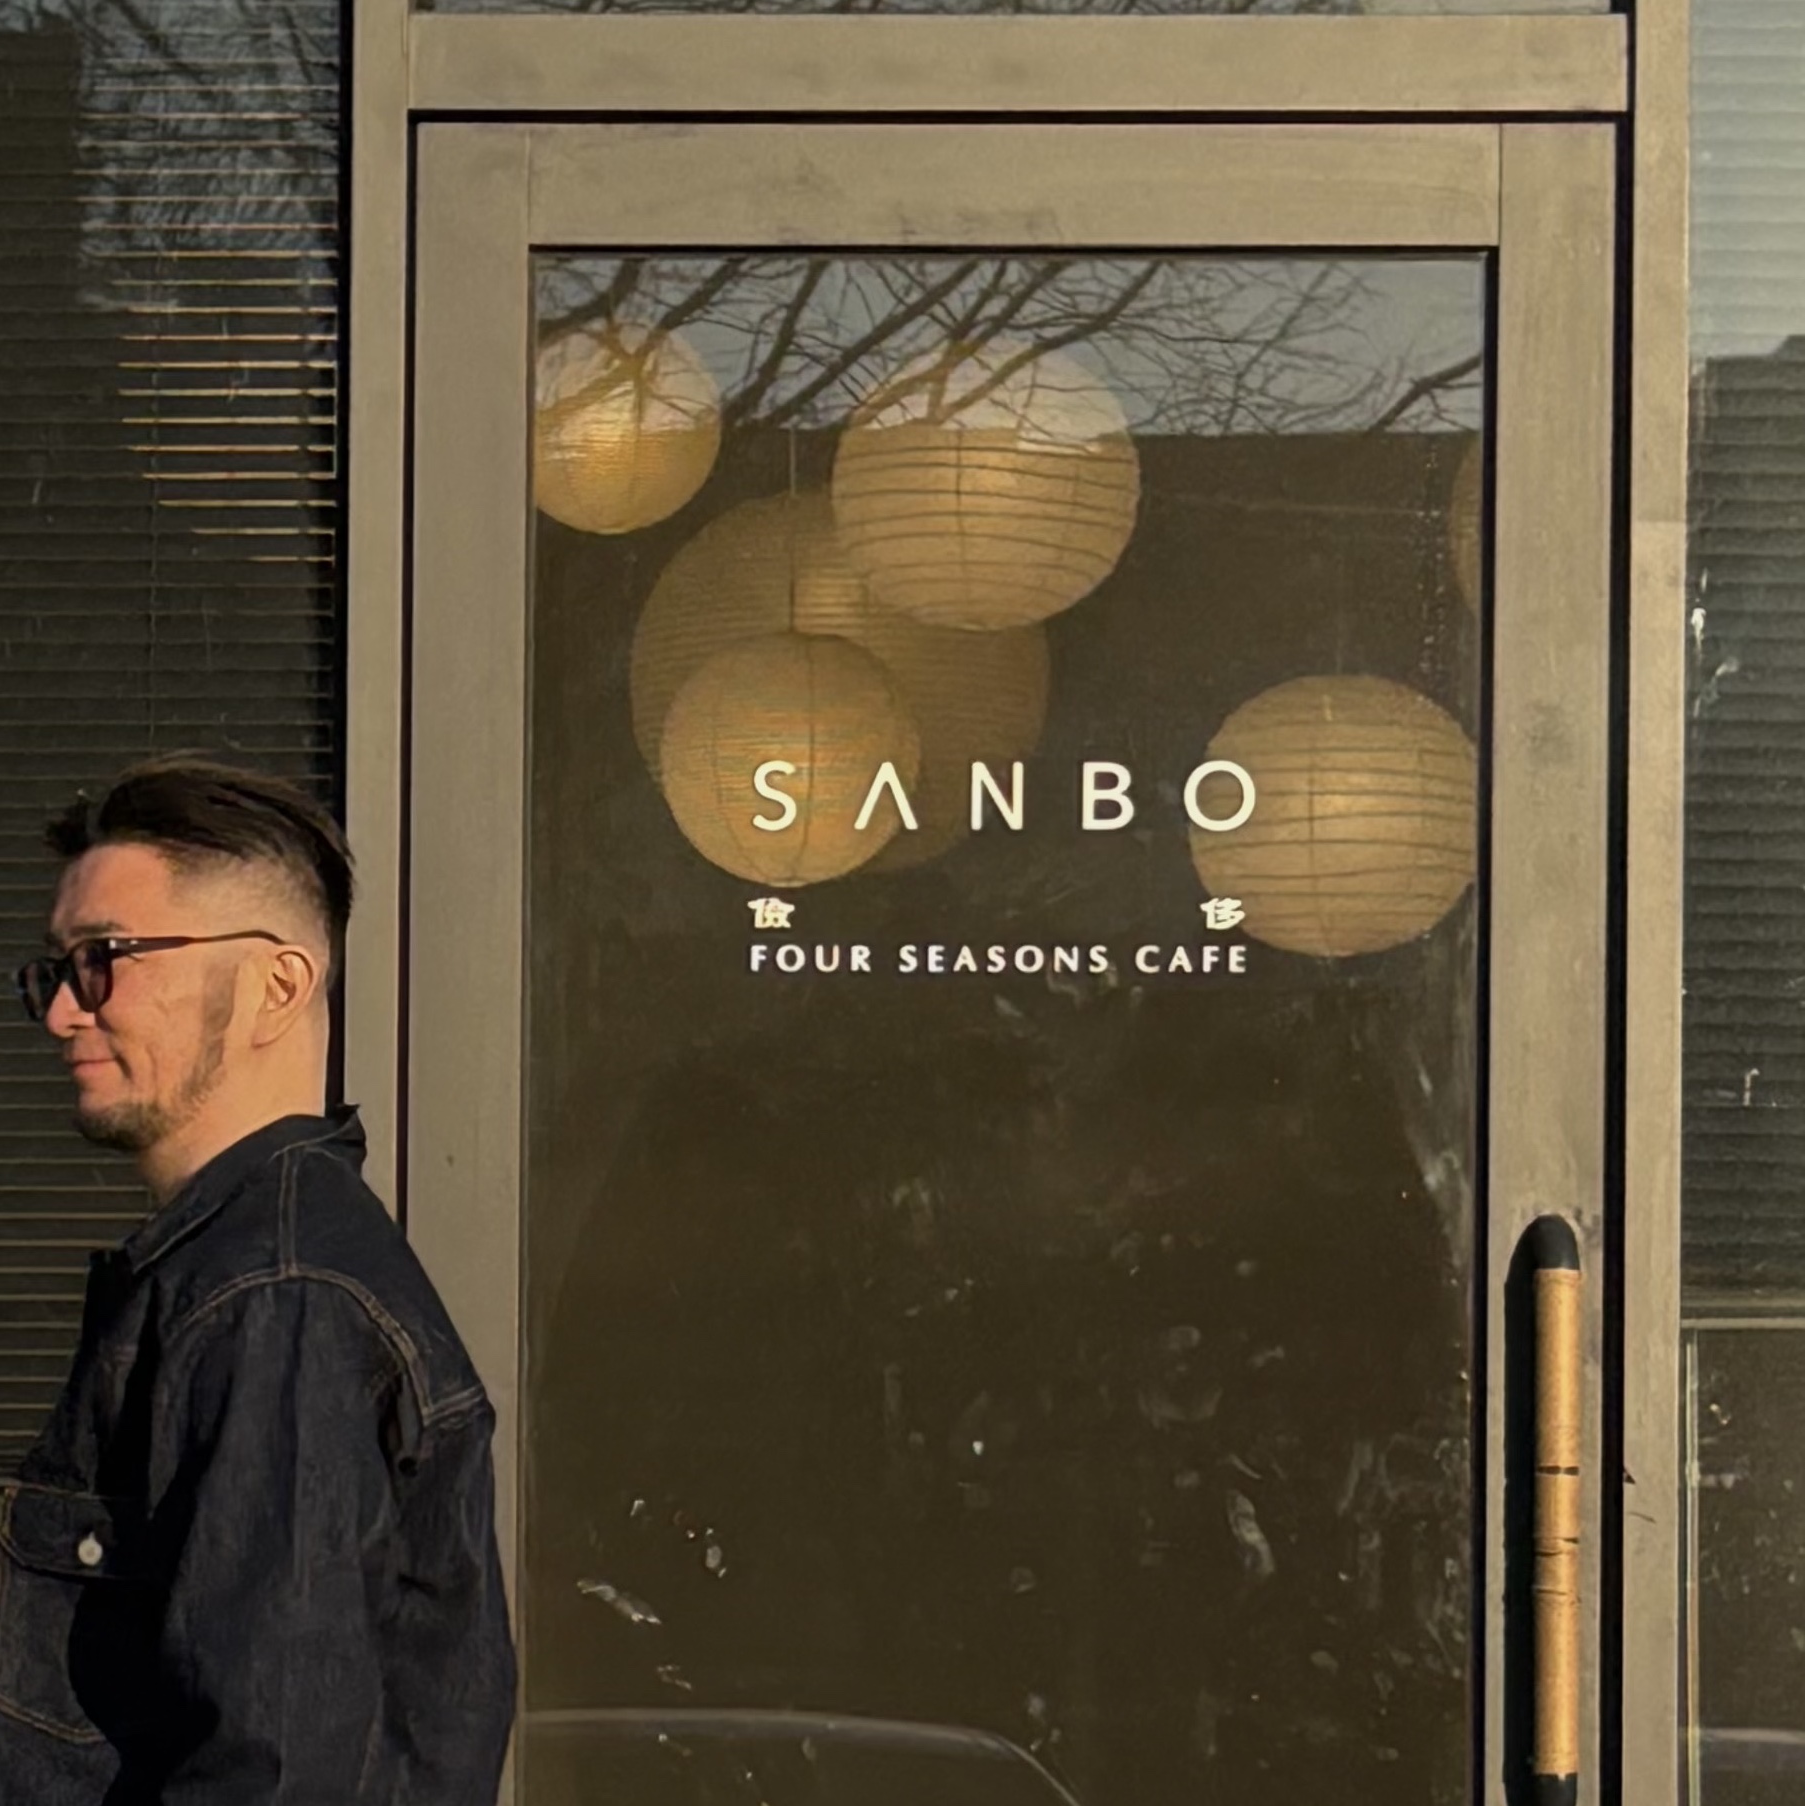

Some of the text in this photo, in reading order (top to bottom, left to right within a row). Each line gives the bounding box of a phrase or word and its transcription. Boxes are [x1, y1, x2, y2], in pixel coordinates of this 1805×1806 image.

[752, 760, 1256, 832] SANBO
[750, 944, 1247, 973] FOUR SEASONS CAFE
